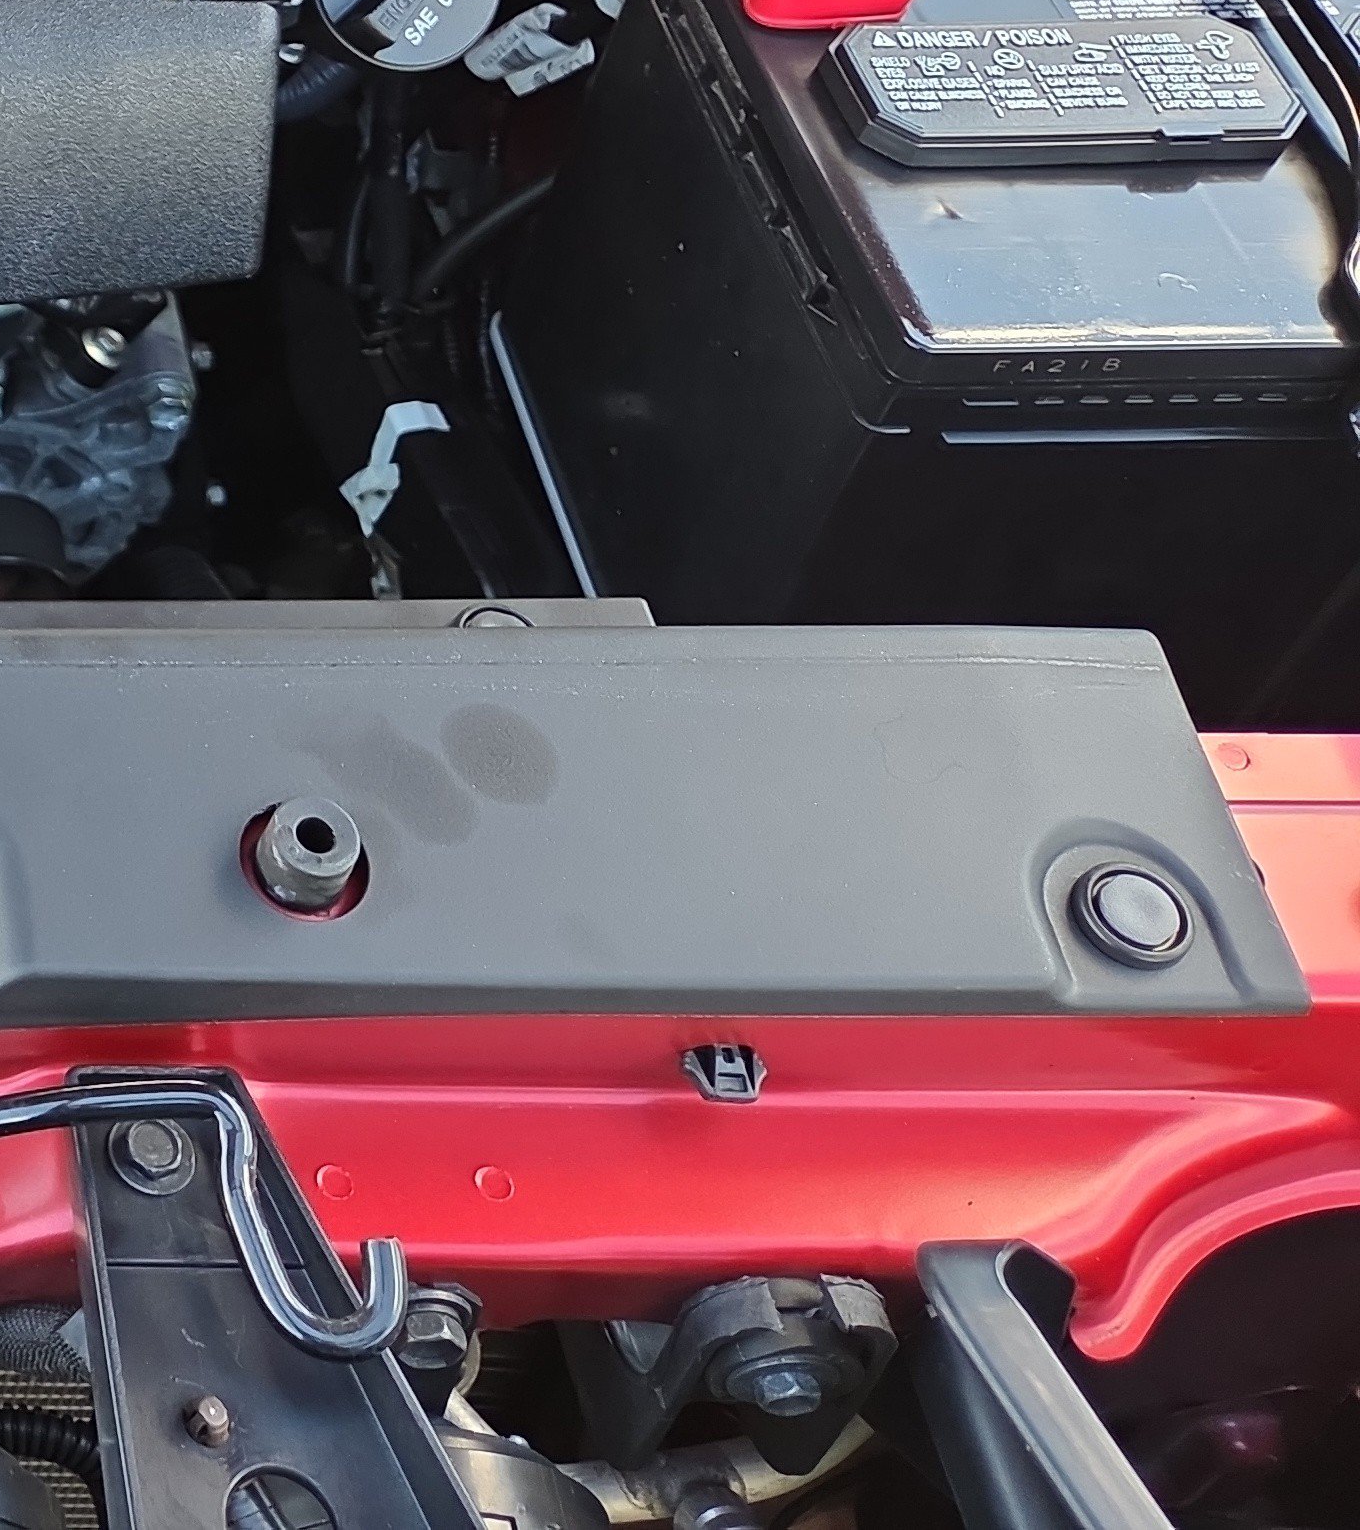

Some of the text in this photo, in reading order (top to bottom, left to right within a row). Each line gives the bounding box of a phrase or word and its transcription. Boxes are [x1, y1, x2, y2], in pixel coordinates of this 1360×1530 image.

[404, 5, 439, 47] SAE
[895, 30, 980, 48] DANGER
[994, 27, 1075, 46] POISON
[870, 55, 912, 69] SHIELD
[875, 68, 907, 79] EYES
[983, 65, 1006, 78] NO
[881, 76, 983, 91] EXPLOSIVE GASES
